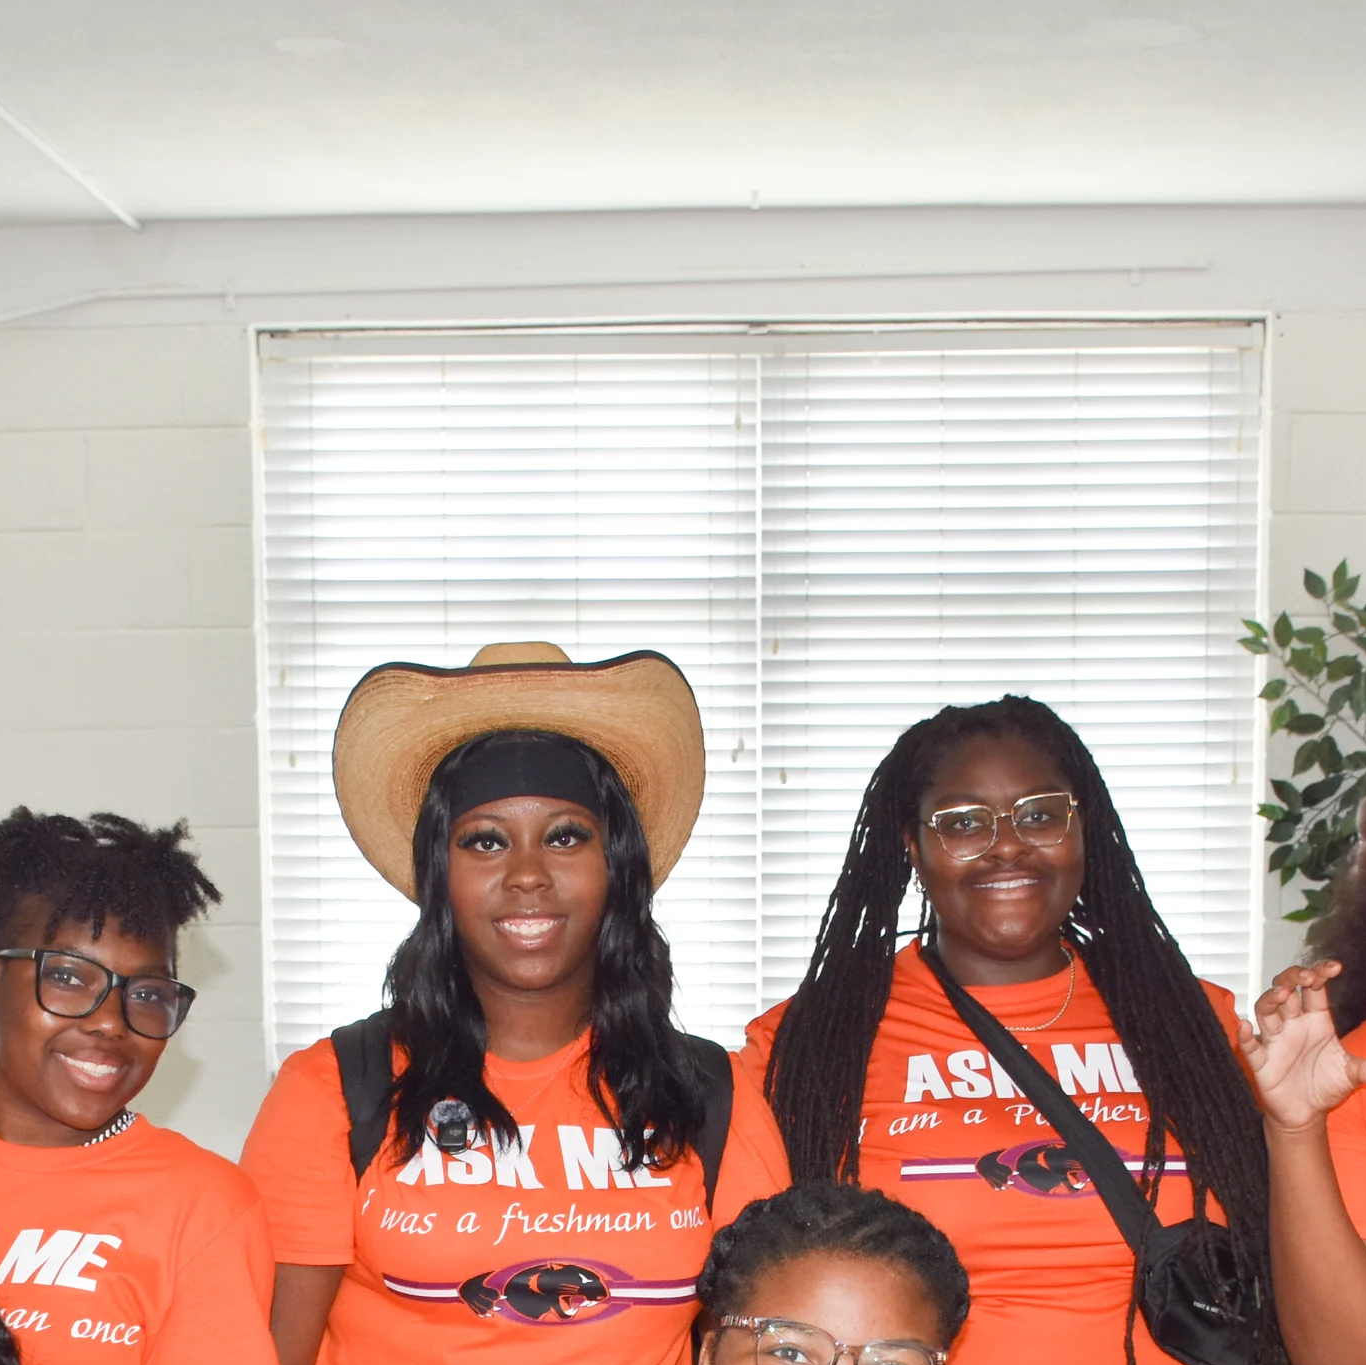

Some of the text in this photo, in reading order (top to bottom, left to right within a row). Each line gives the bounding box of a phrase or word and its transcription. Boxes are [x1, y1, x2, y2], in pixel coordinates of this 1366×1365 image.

[888, 1111, 942, 1136] am
[963, 1108, 988, 1124] a
[396, 1124, 544, 1190] ASK
[380, 1207, 437, 1234] was
[456, 1210, 481, 1234] a
[493, 1202, 656, 1246] freshman
[71, 1317, 140, 1346] once
